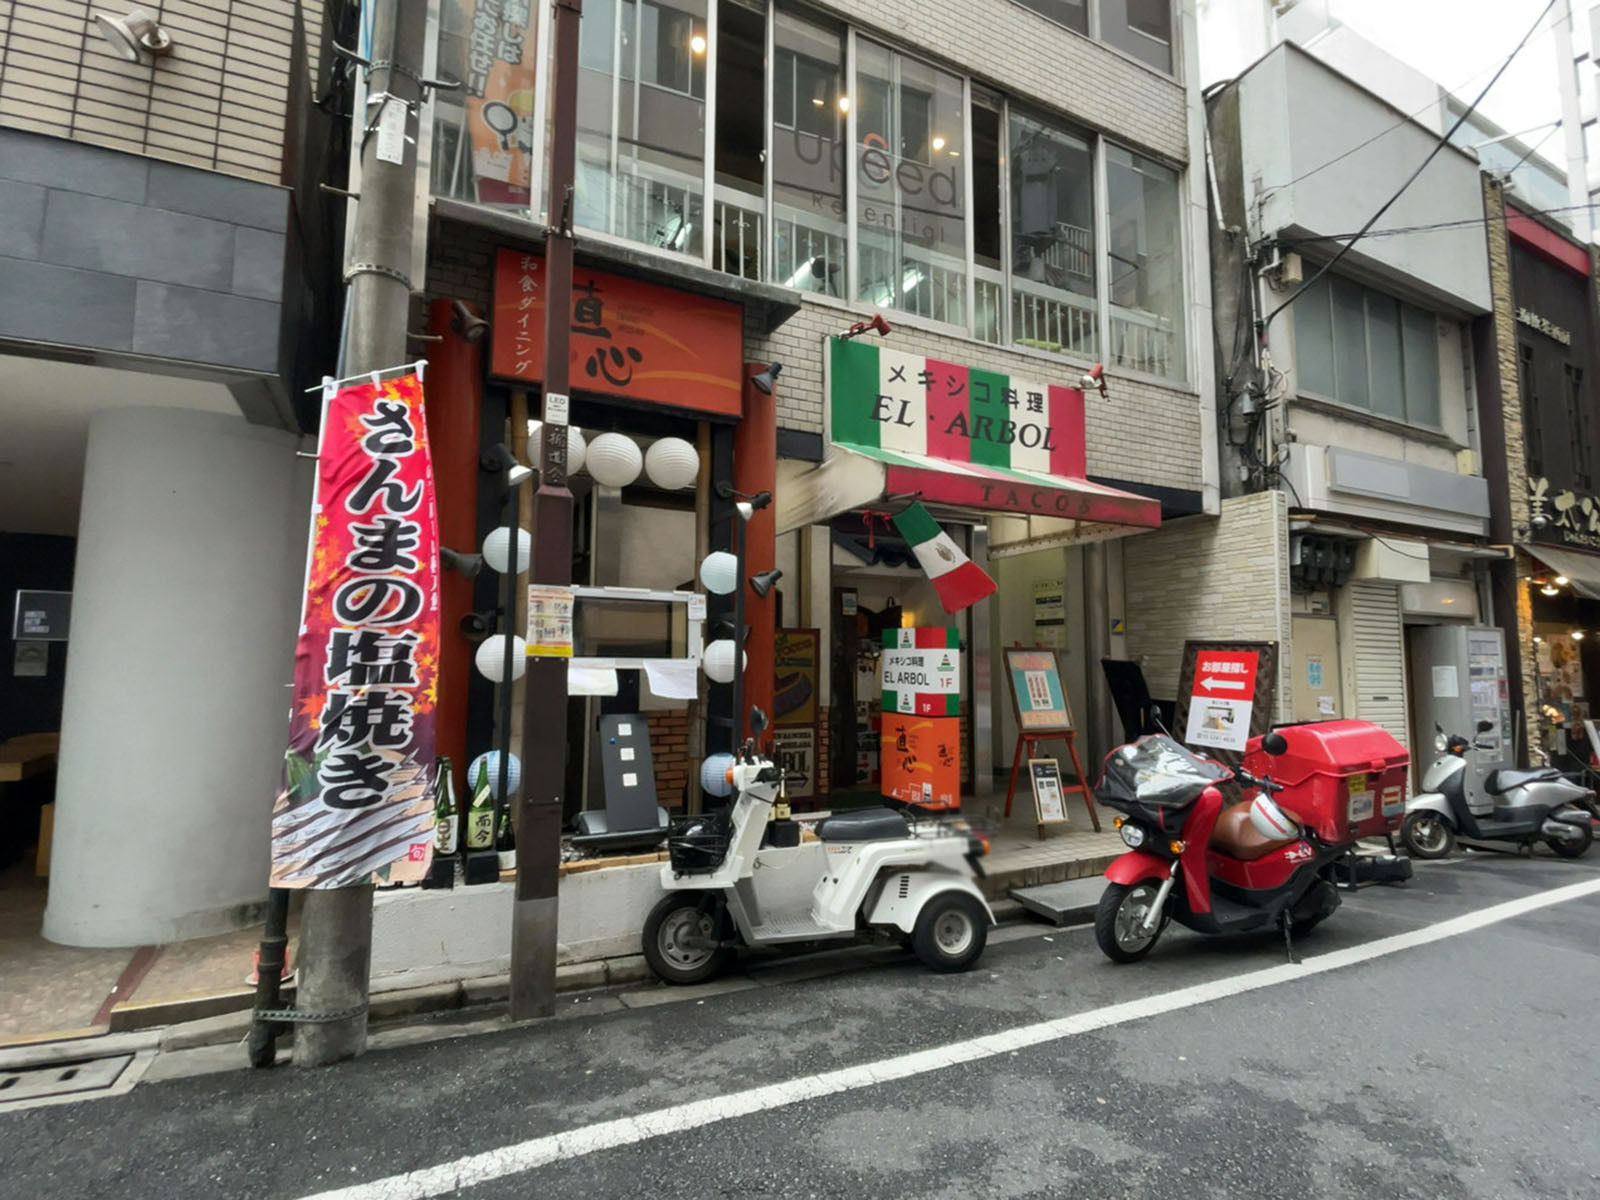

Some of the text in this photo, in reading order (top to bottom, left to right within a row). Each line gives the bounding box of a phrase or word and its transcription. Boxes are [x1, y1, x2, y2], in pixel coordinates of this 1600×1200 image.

[515, 255, 539, 375] 和食ダイニング
[888, 365, 1044, 414] メキシコ料理
[869, 394, 1056, 451] EL ARBOL
[980, 484, 1091, 514] TACOS
[318, 401, 424, 810] さんまの塩焼き
[884, 671, 953, 689] EL ARBOL 1F
